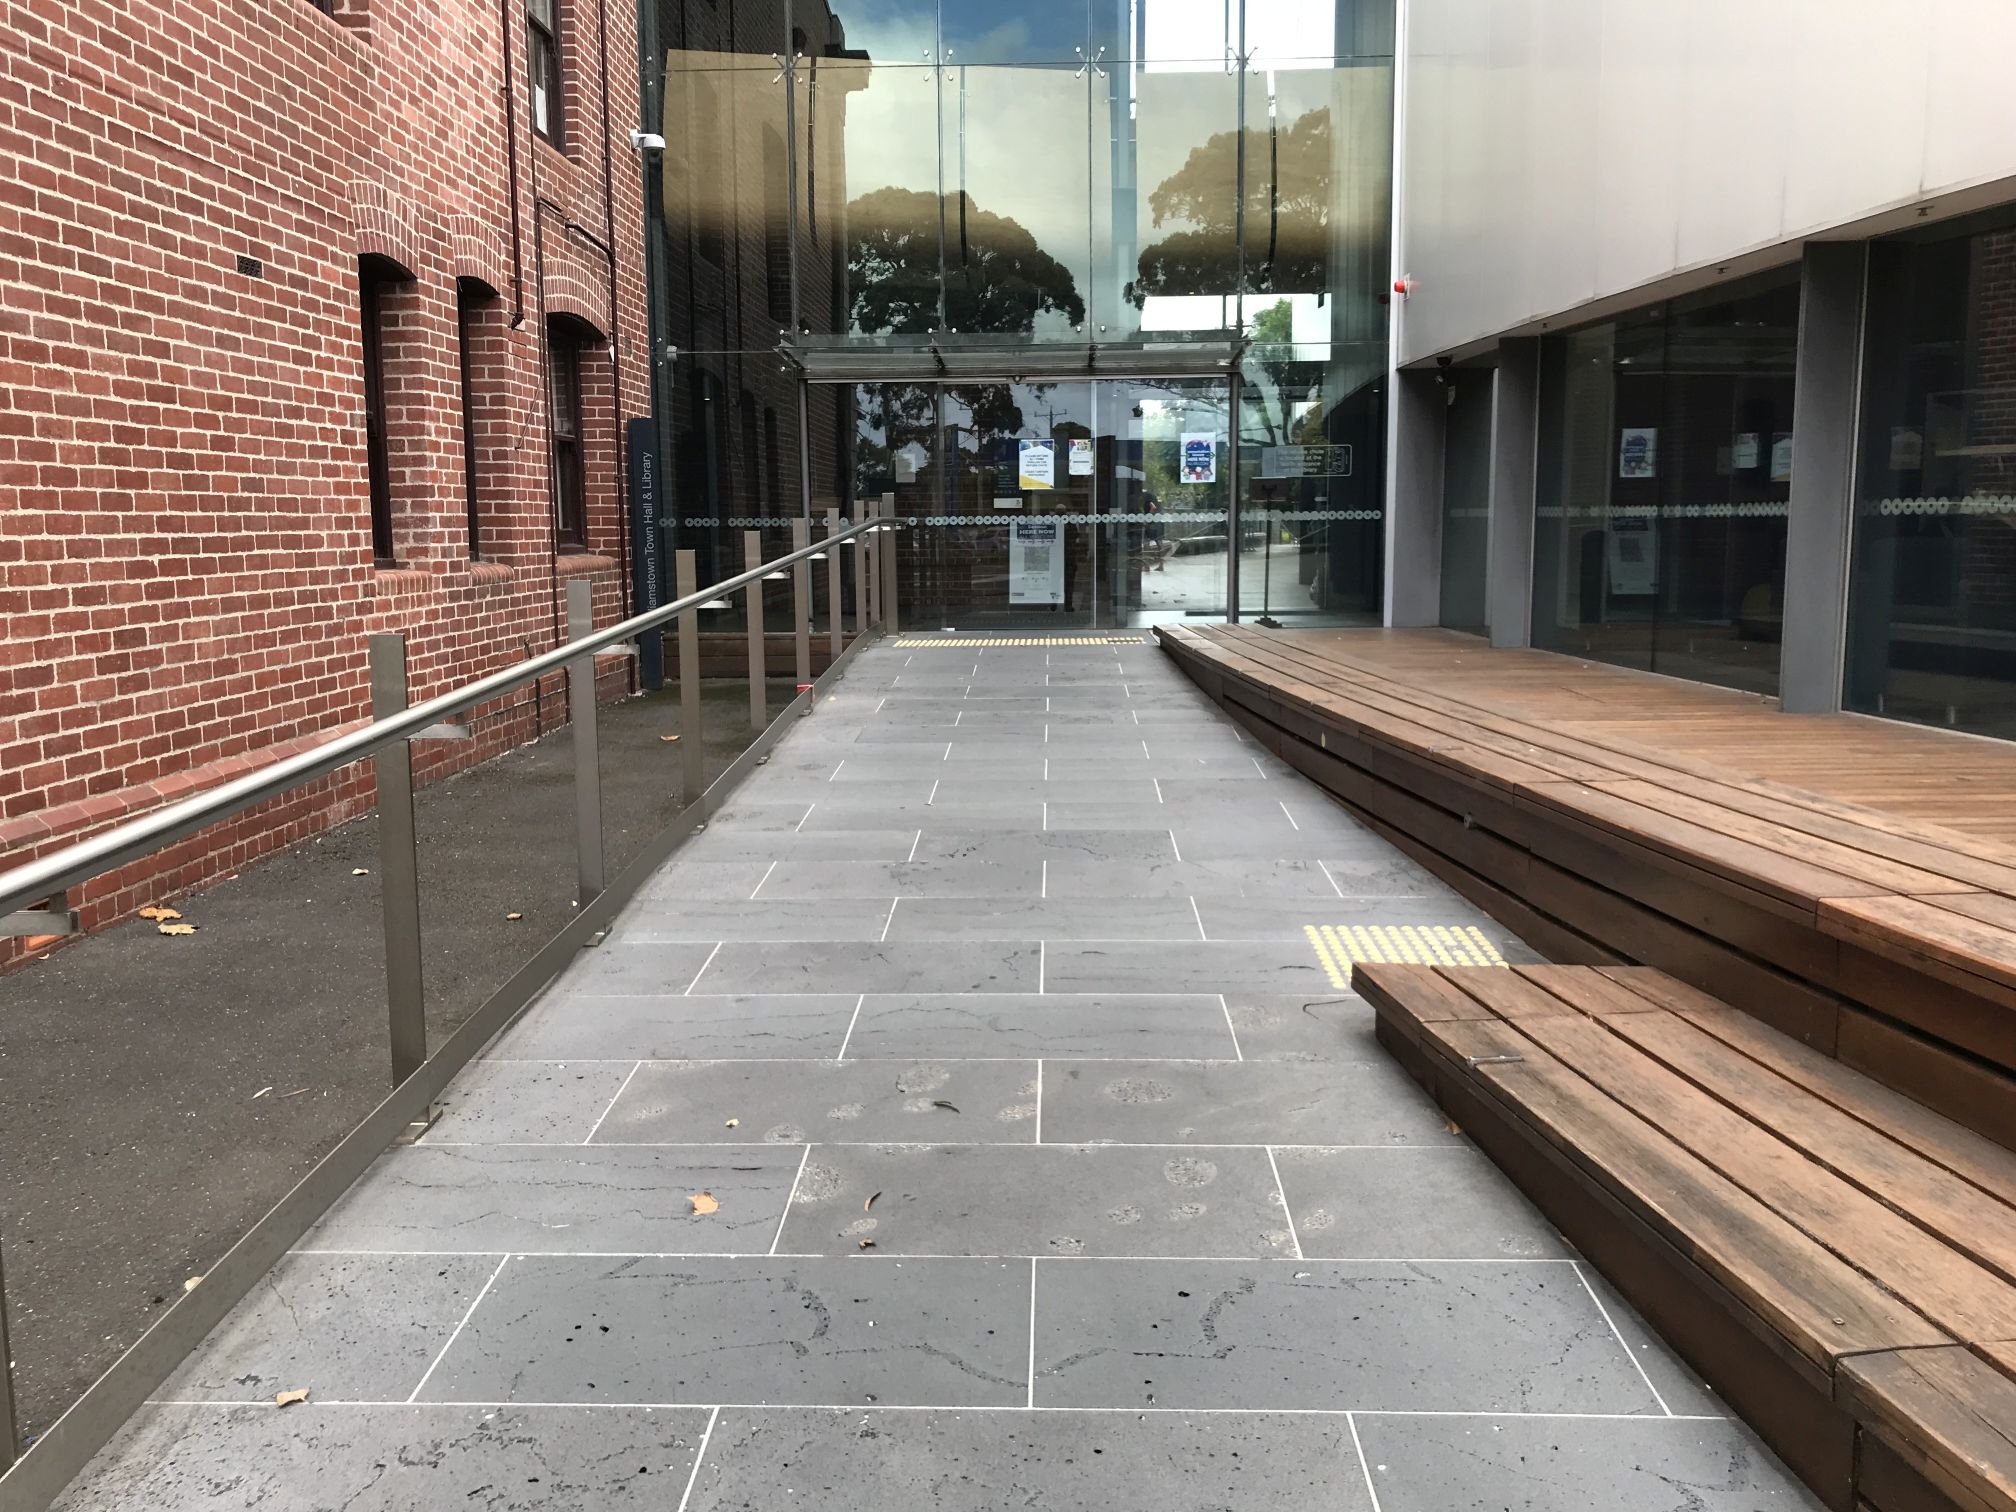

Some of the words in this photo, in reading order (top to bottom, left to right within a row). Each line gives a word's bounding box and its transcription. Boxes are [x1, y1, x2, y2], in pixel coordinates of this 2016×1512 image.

[641, 451, 653, 489] Library
[642, 491, 652, 500] &
[642, 503, 653, 523] Hall
[644, 526, 654, 556] Town
